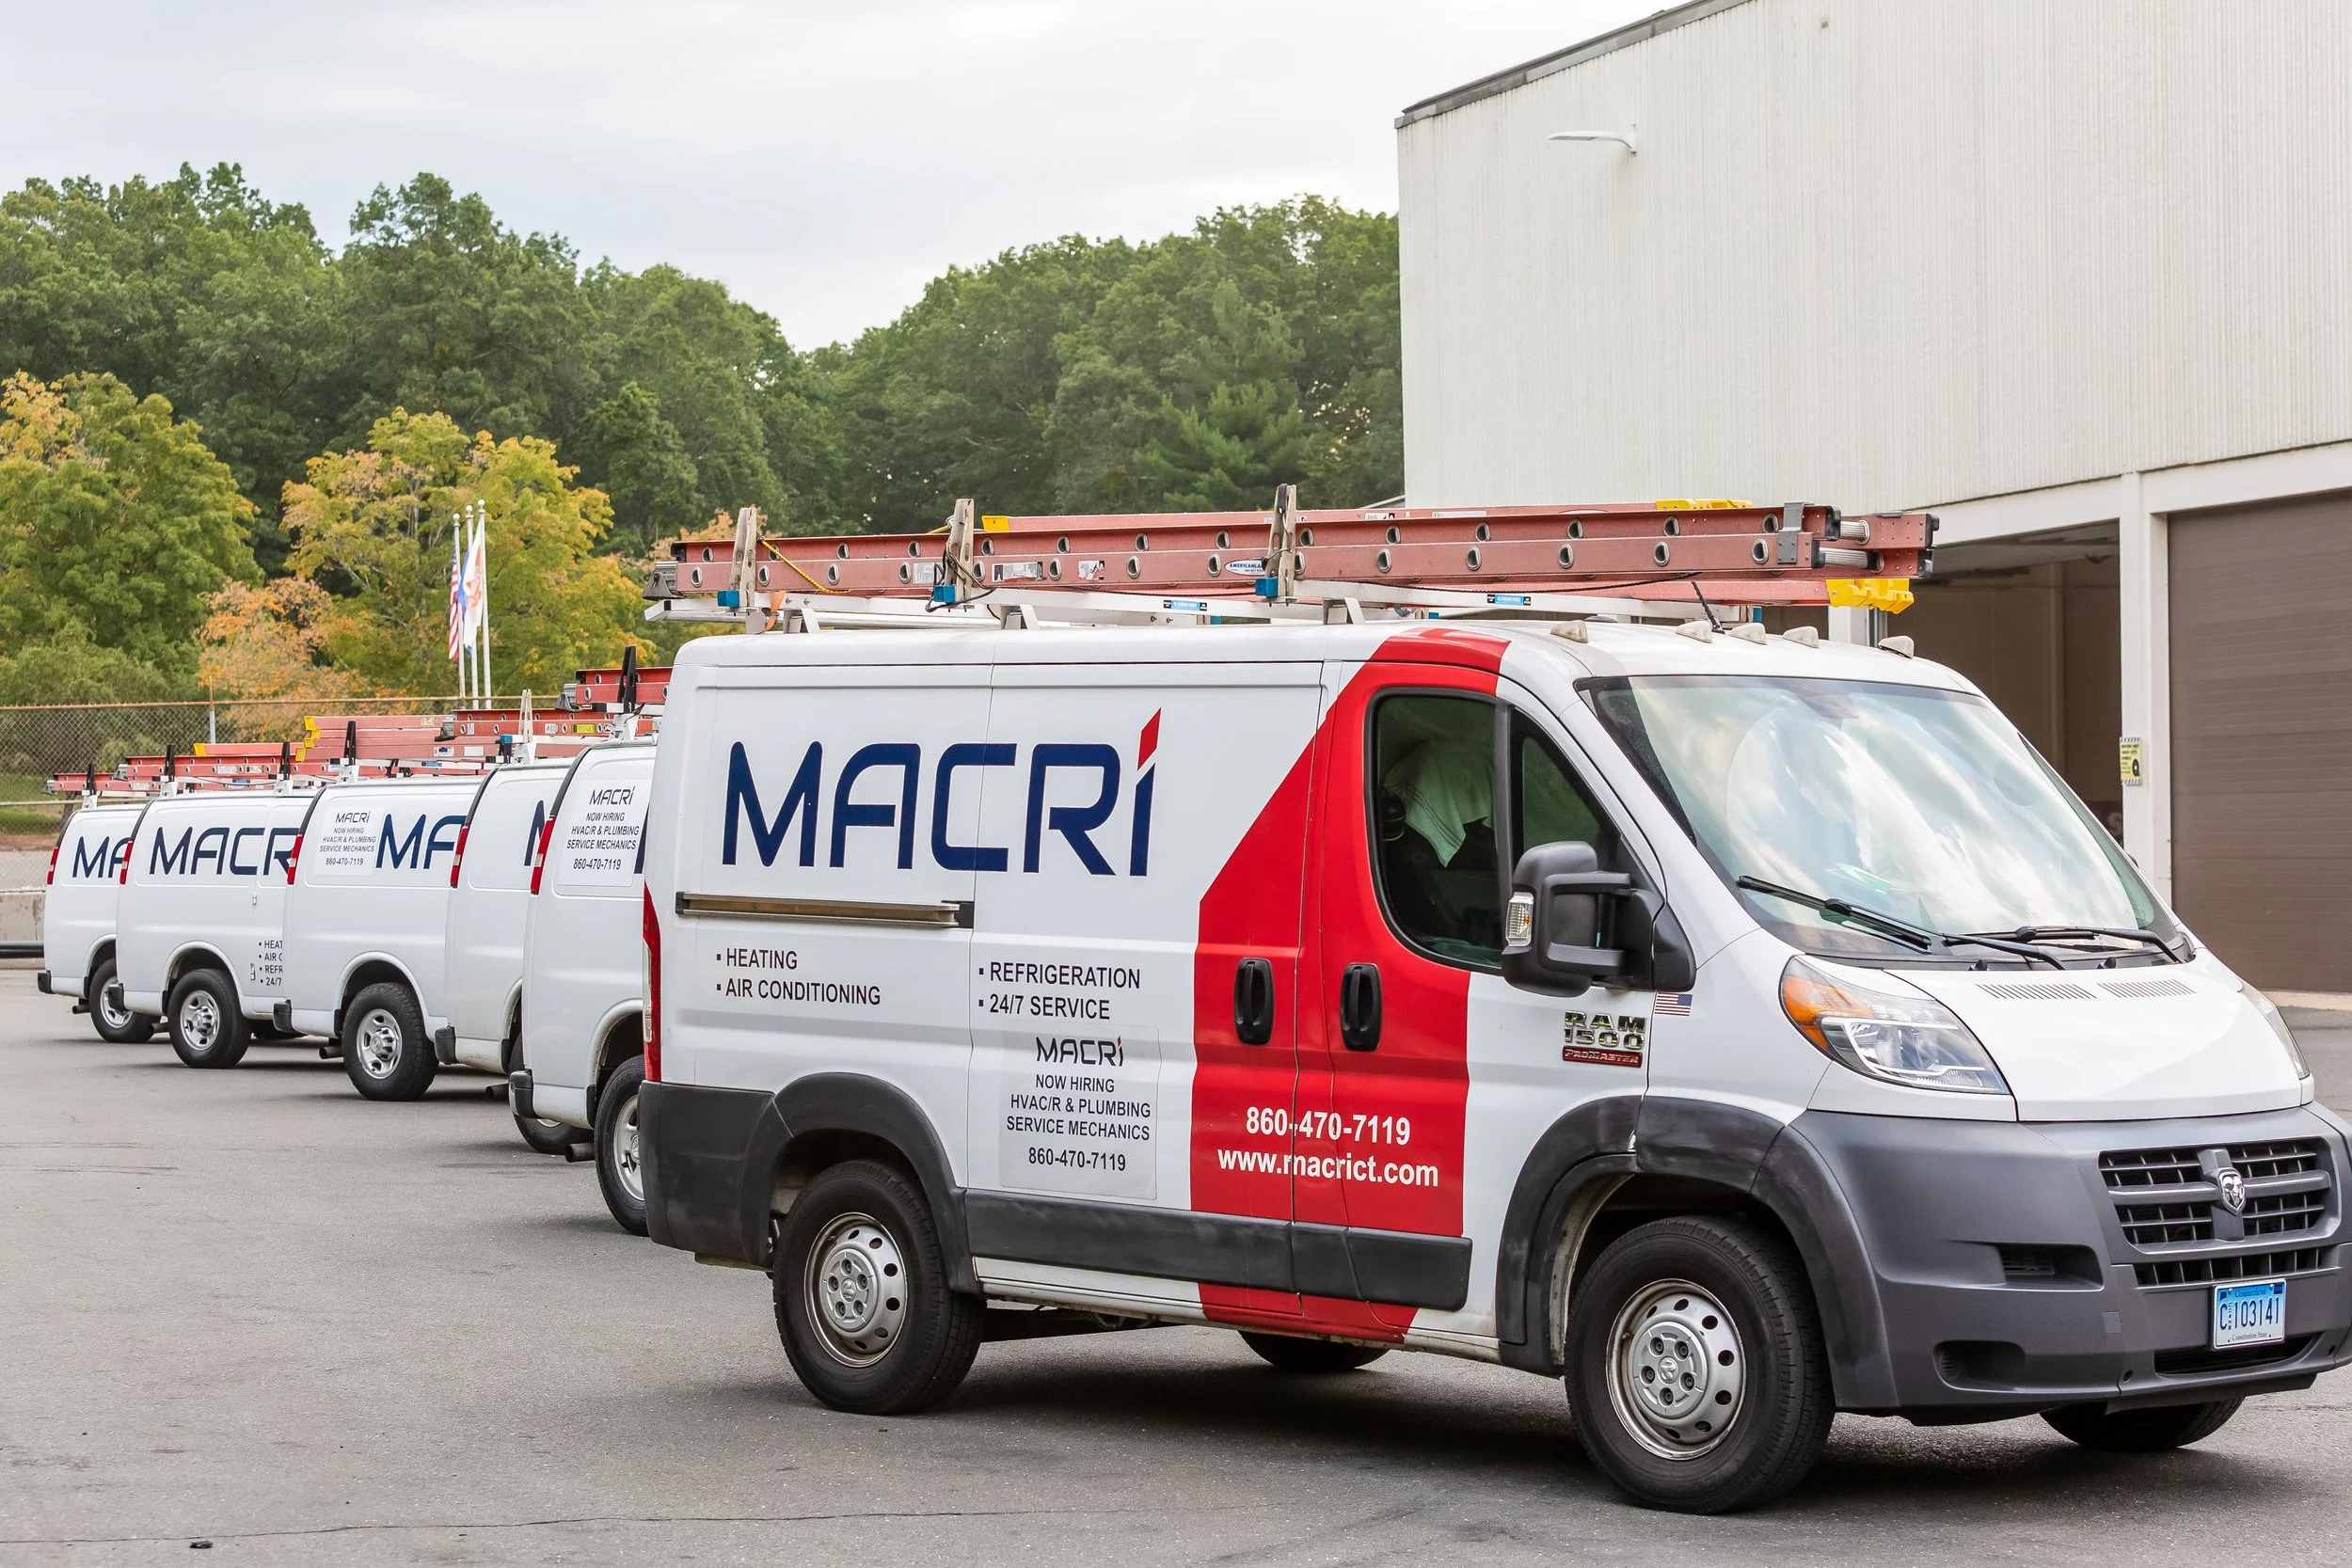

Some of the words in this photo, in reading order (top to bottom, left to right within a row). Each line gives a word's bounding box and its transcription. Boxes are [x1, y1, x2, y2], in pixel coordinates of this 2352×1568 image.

[589, 785, 636, 805] MACRI
[723, 707, 1162, 877] MACRI
[336, 811, 371, 823] MACRI
[586, 813, 602, 821] NOW
[602, 813, 626, 821] HIRING
[571, 826, 596, 835] HVAC/R
[597, 826, 602, 835] &
[603, 826, 640, 835] PLUMBING
[567, 839, 595, 849] SERVICE
[596, 839, 637, 850] MECHANICS
[573, 858, 622, 870] 860-470-7119
[264, 952, 277, 961] AIR
[726, 948, 798, 971] HEATING
[265, 976, 282, 987] 24/7
[990, 961, 1141, 990] REFRIGERATION
[725, 978, 753, 999] AIR
[757, 979, 881, 1006] CONDITIONING
[990, 993, 1024, 1016] 24/7
[1030, 995, 1110, 1020] SERVICE
[1565, 1009, 1646, 1035] RAM
[1564, 1026, 1645, 1050] 1500
[1036, 1036, 1123, 1067] MACRI
[1036, 1074, 1067, 1090] NOW
[1070, 1076, 1115, 1093] HIRING
[1010, 1094, 1061, 1112] HVAC/R
[1065, 1097, 1074, 1113] &
[1078, 1099, 1151, 1117] PLUMBING
[1007, 1116, 1064, 1134] SERVICE
[1068, 1120, 1150, 1141] MECHANICS
[1246, 1106, 1411, 1146] 860-470-7119
[1028, 1147, 1126, 1171] 860-470-7119
[1217, 1148, 1438, 1187] www.macrict.com
